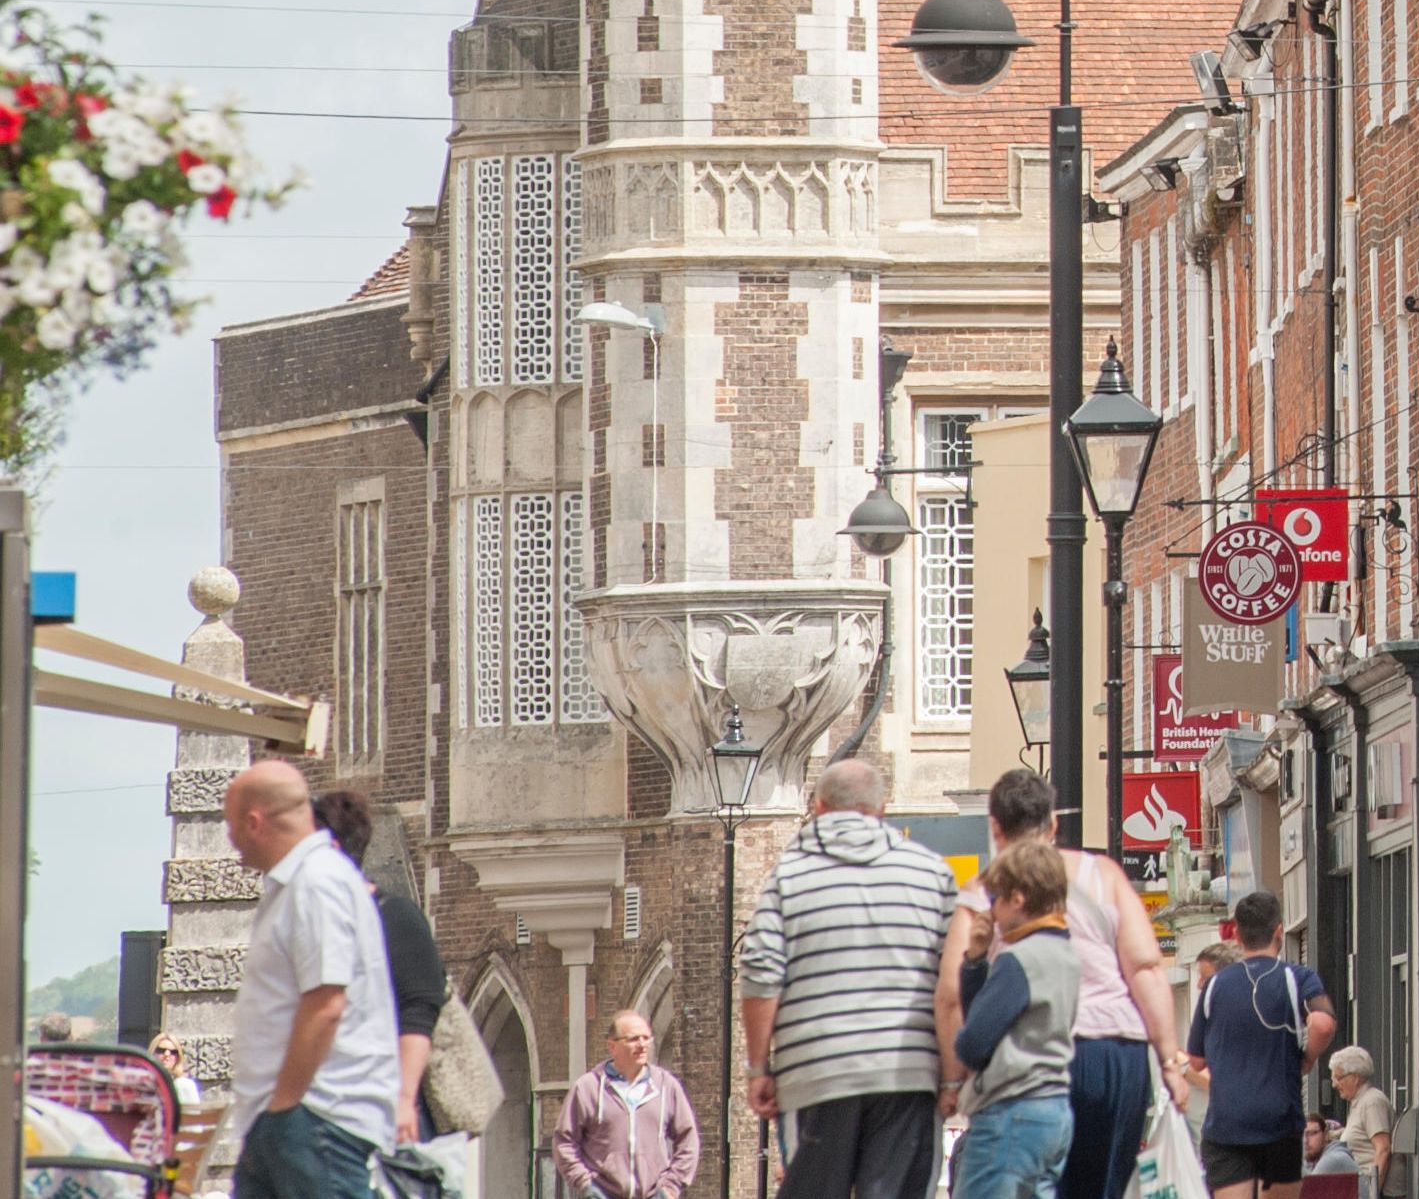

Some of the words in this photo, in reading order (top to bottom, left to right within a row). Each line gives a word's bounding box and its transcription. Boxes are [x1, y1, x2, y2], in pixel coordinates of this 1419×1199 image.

[1217, 530, 1282, 558] COSTA
[1212, 582, 1291, 617] COFFEE
[1162, 727, 1197, 737] British
[1162, 737, 1218, 749] Foundati
